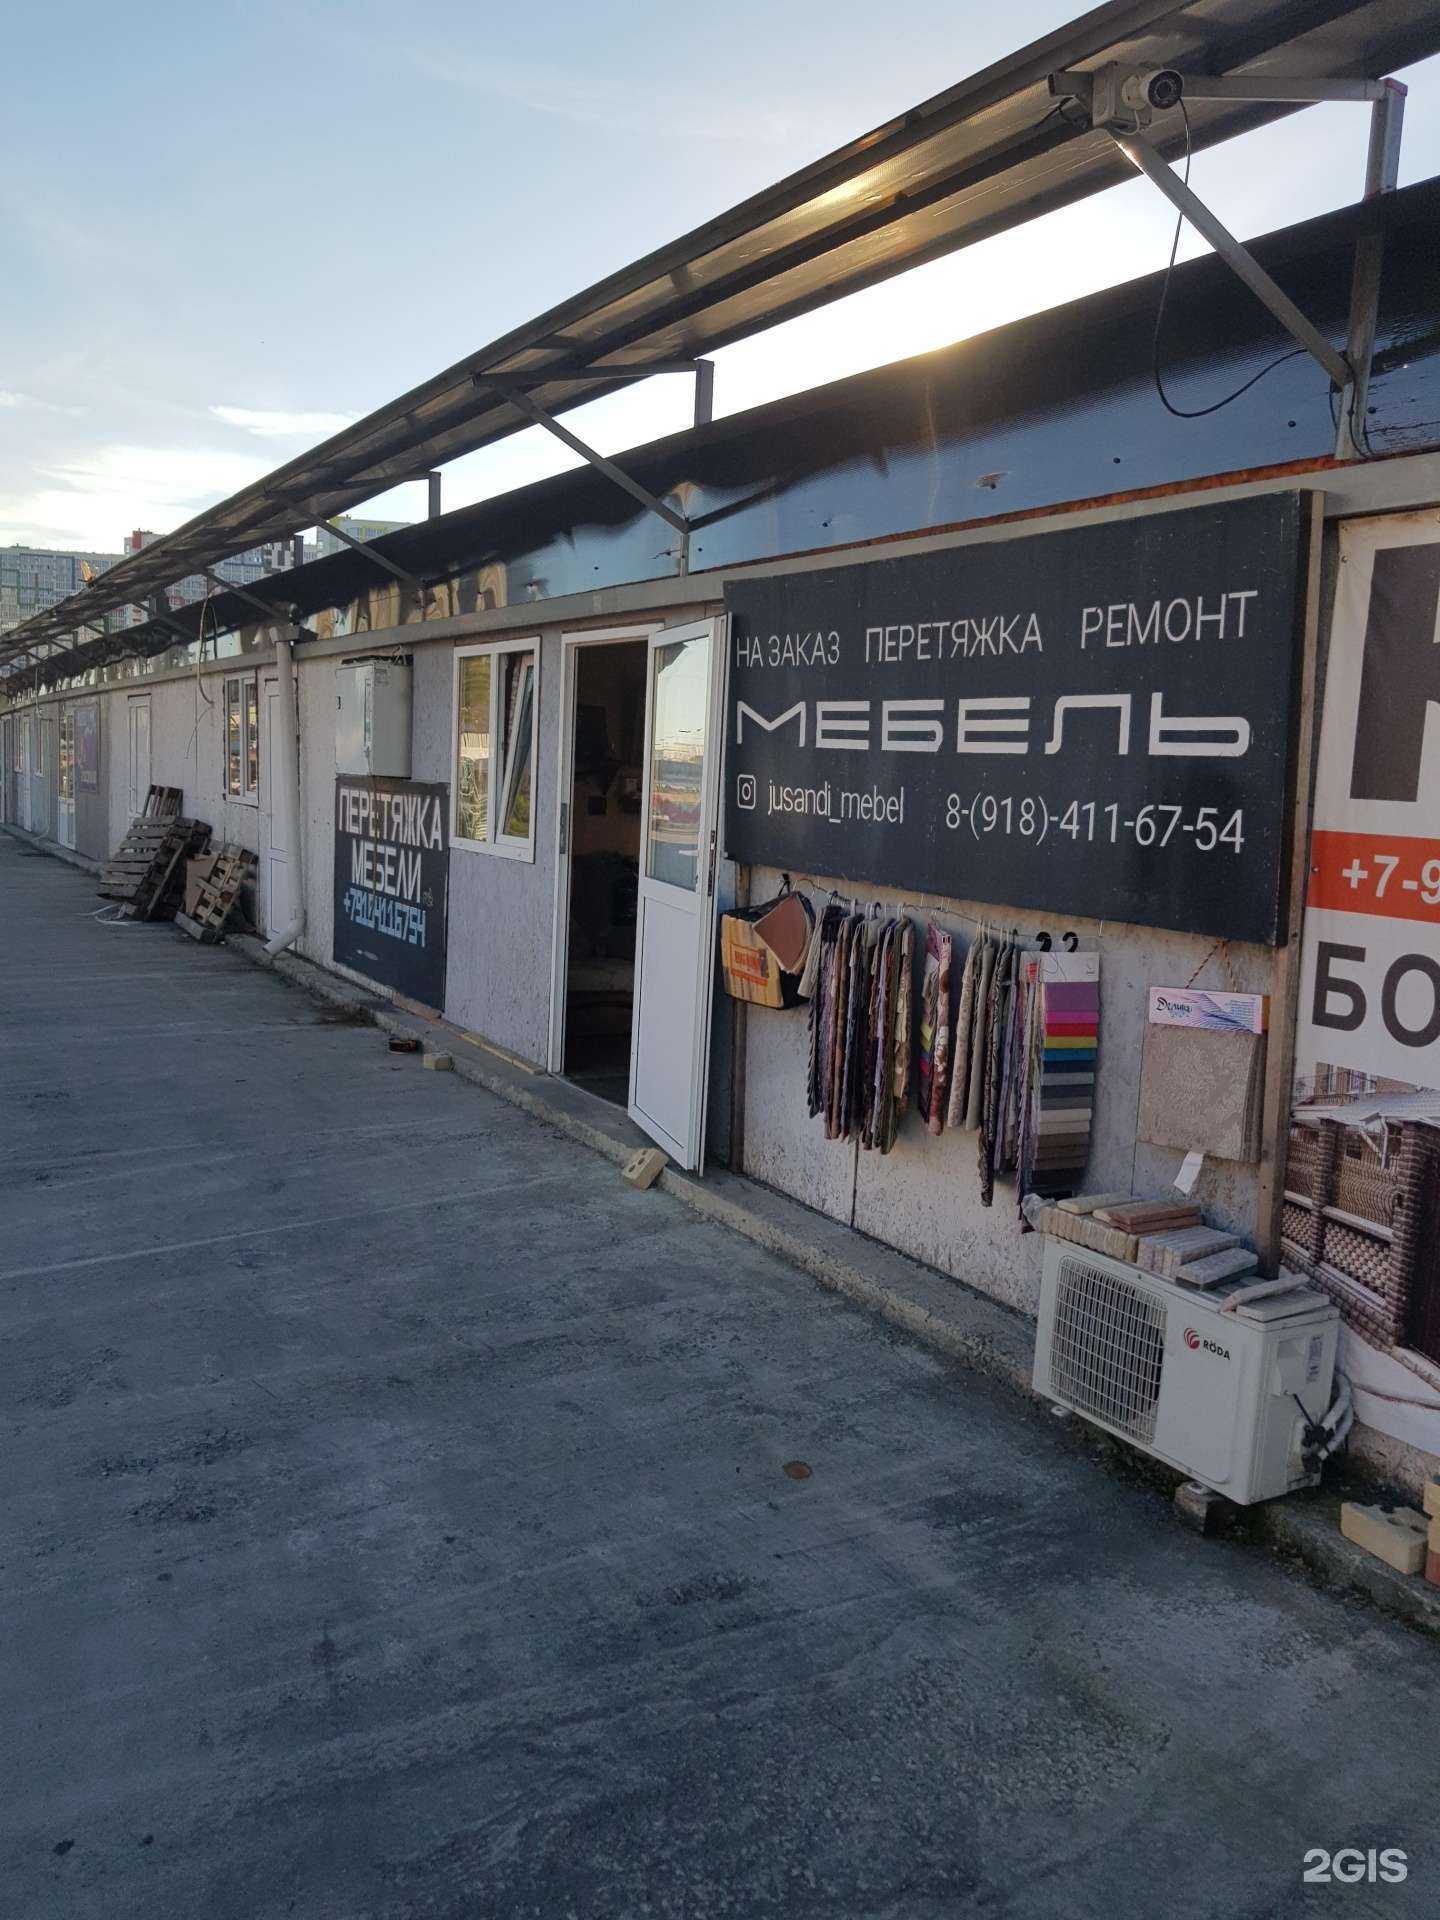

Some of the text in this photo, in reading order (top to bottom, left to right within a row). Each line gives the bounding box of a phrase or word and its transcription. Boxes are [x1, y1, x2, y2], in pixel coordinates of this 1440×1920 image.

[736, 590, 1259, 668] НА ЗАКАЗ ПЕРЕТЯЖКА РЕМОНТ
[736, 691, 1251, 758] МЕБЕЛЬ
[338, 787, 443, 852] ПЕРЕТЯЖКА
[767, 778, 905, 824] jusandi_mebel
[945, 792, 1245, 854] 8-(918)-411-67-54
[351, 837, 422, 904] МЕБЕЛИ
[1312, 940, 1440, 1048] БО
